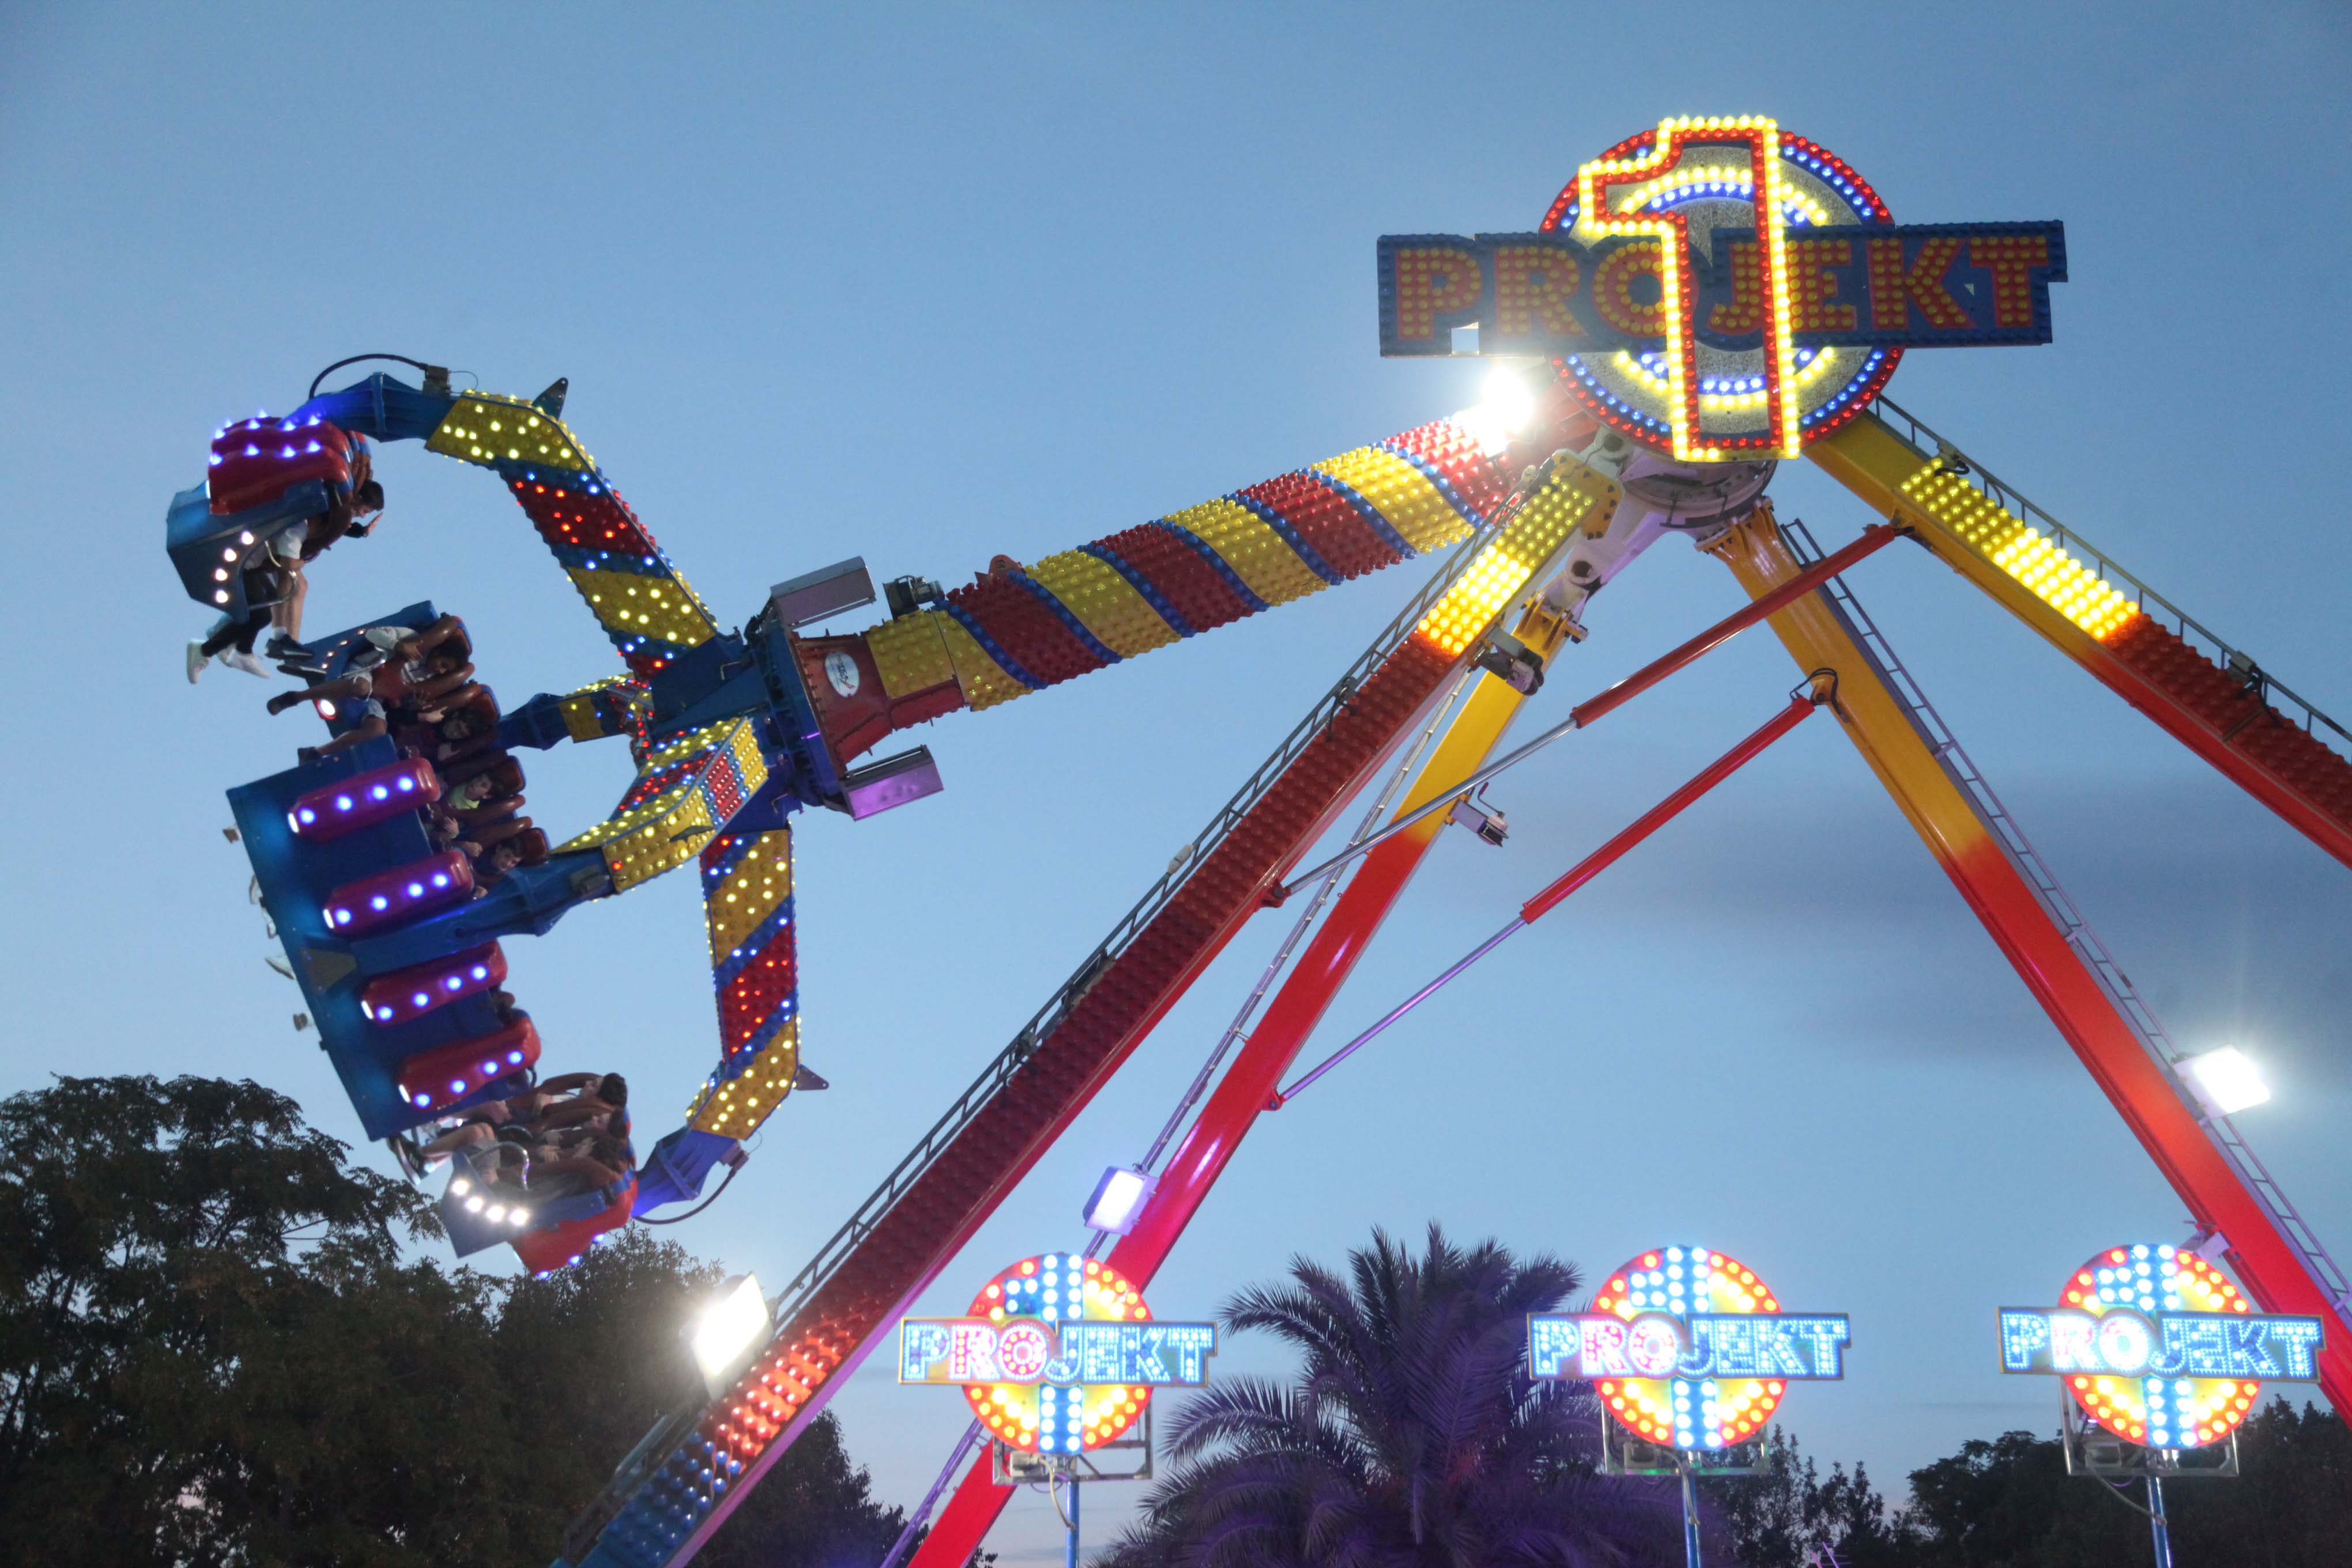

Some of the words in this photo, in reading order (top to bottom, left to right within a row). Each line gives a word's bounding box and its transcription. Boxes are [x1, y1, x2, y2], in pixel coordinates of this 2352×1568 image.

[1394, 233, 2050, 340] PROJEKT
[1578, 114, 1800, 460] 1
[903, 1324, 1212, 1383] PROJEKT
[1532, 1318, 1849, 1376] PROJEKT
[2000, 1313, 2322, 1378] PROJEKT
